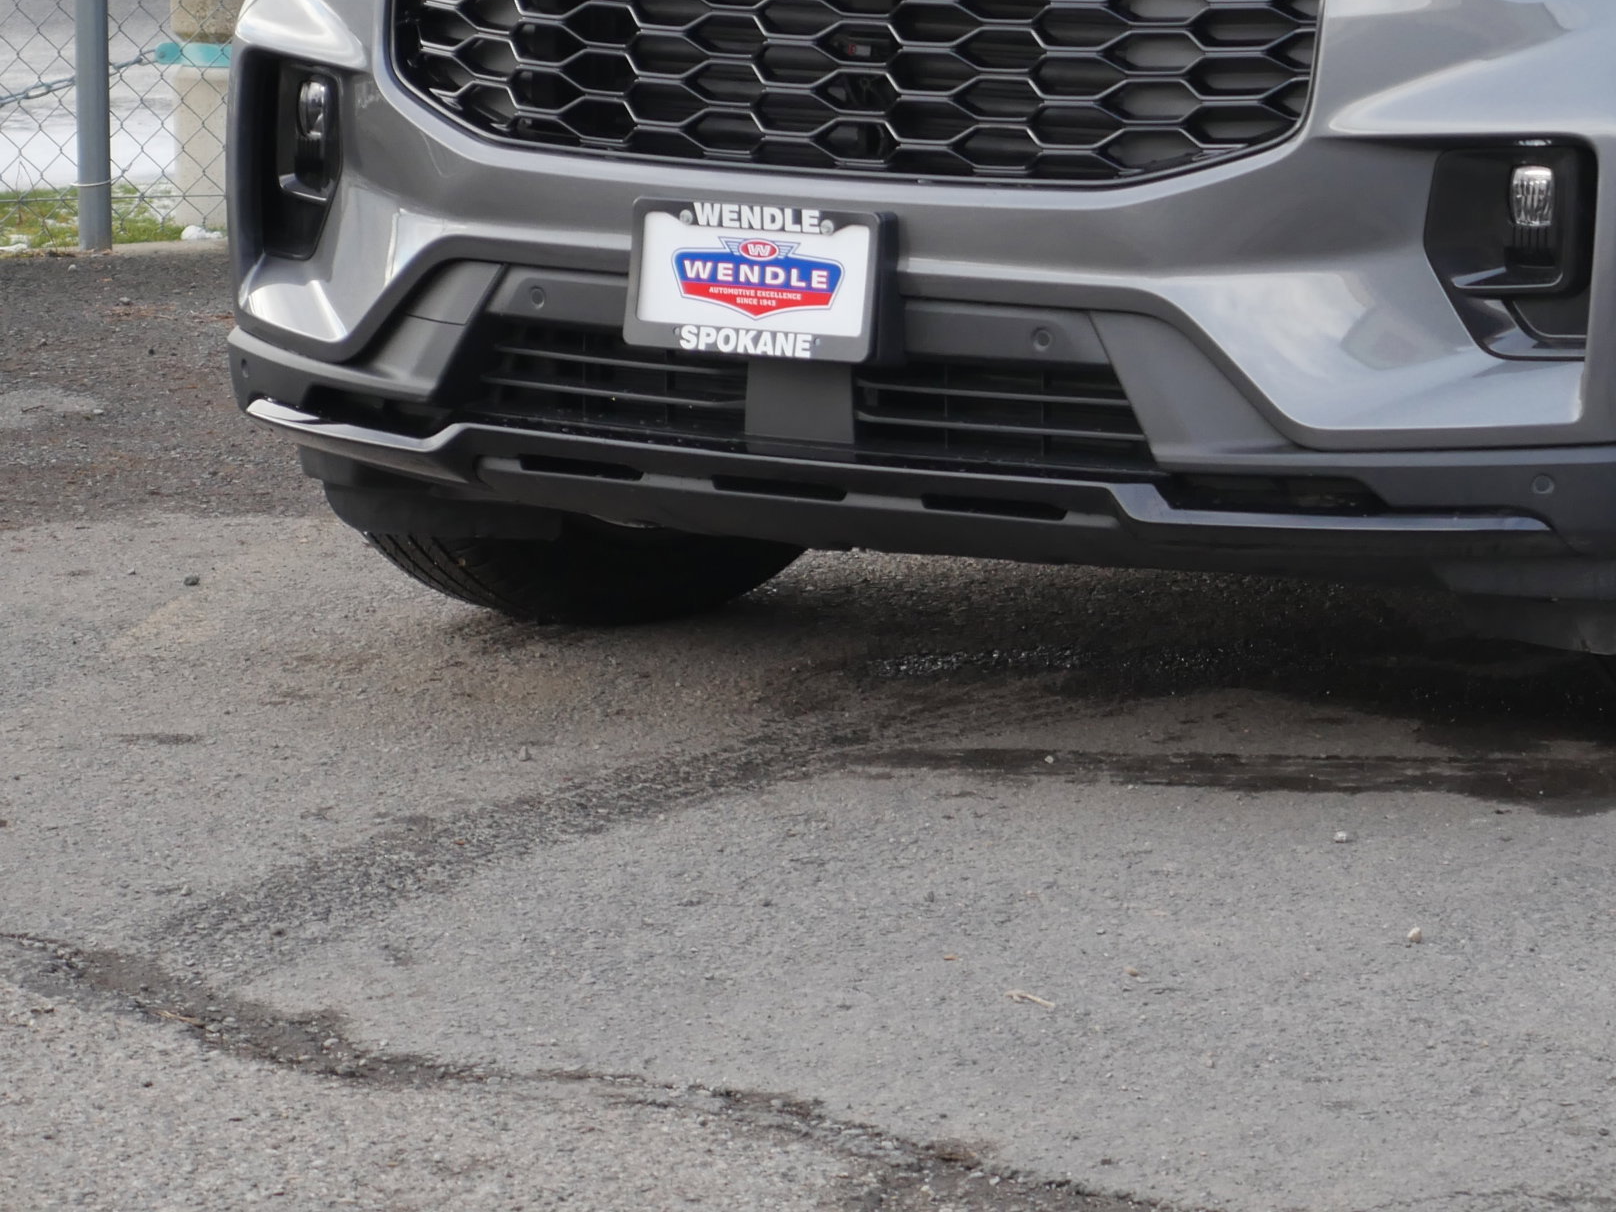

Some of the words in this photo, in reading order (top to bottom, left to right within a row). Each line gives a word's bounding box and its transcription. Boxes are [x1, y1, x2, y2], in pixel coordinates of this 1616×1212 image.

[693, 202, 820, 234] WENDLE
[683, 259, 828, 289] WENDLE
[709, 286, 756, 297] AUTOMOTIVE
[757, 290, 802, 301] EXCELLENCE
[736, 296, 758, 306] SINCE
[759, 299, 777, 307] 1943
[679, 324, 813, 359] SPOKANE
